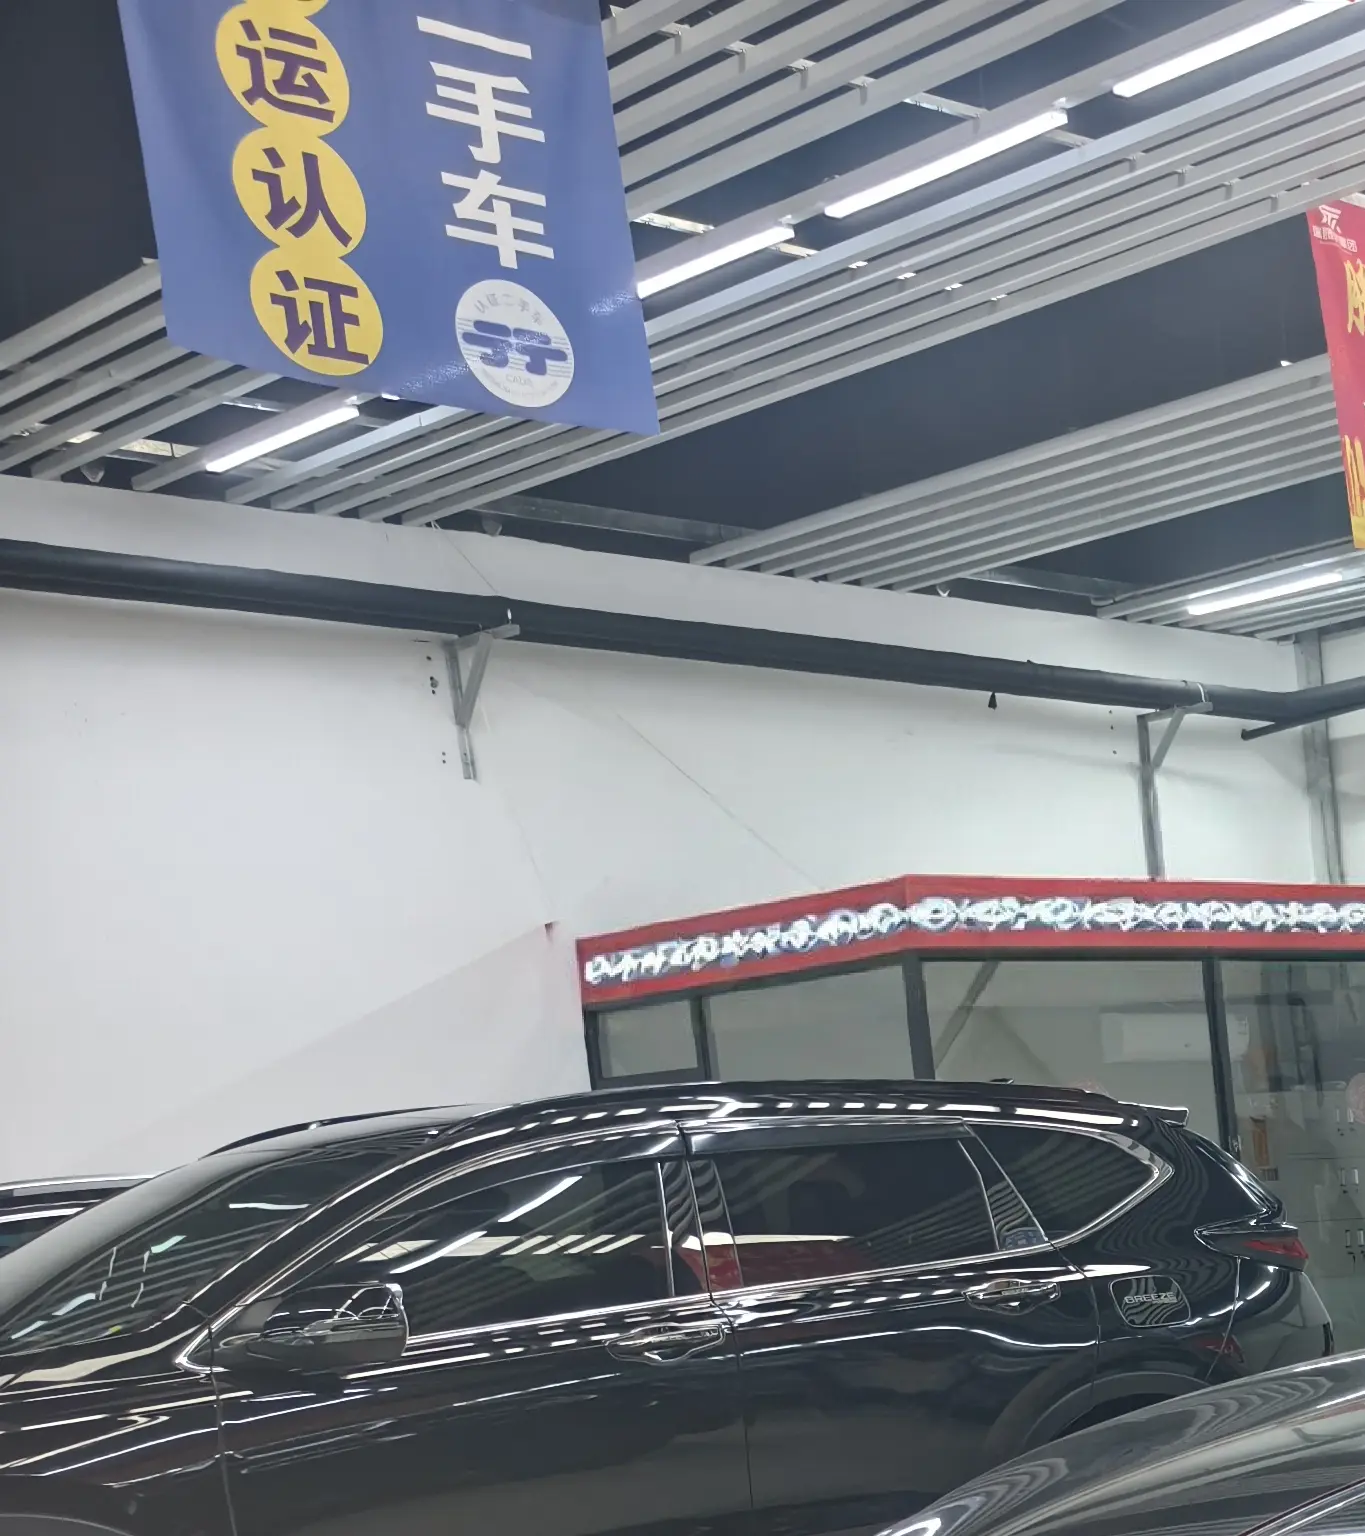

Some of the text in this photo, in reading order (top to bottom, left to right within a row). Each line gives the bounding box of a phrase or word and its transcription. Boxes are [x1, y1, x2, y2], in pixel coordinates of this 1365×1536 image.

[235, 19, 370, 366] 运认证
[1124, 1291, 1177, 1304] BREEZE
